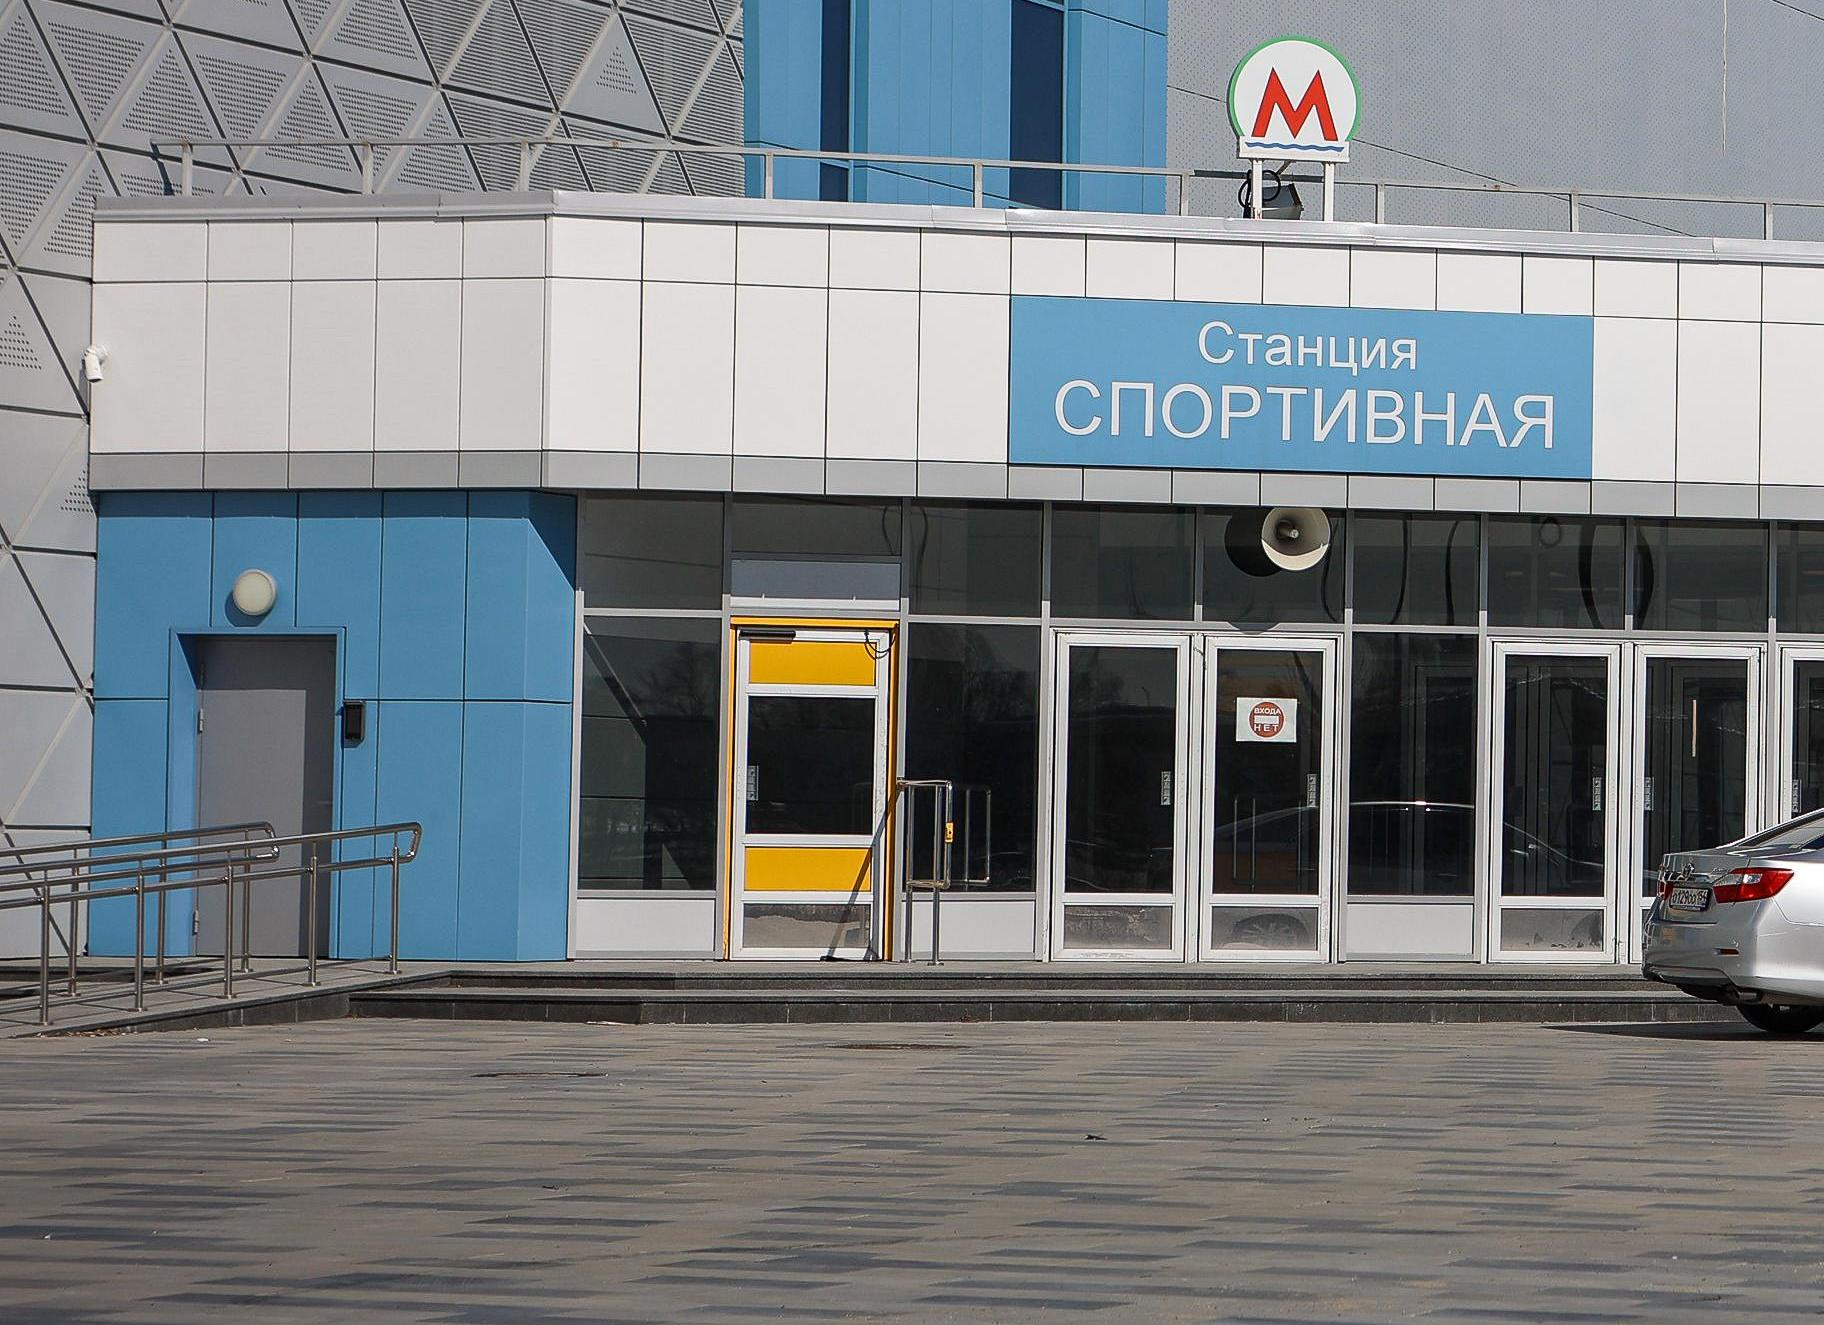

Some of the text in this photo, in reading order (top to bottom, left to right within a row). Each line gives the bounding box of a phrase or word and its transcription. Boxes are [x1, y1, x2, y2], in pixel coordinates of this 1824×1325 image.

[1251, 66, 1339, 142] М
[1198, 320, 1418, 377] Станция
[1055, 379, 1556, 450] СПОРТИВНАЯ
[1253, 707, 1281, 715] ВХОДА
[1253, 724, 1279, 732] НЕТ
